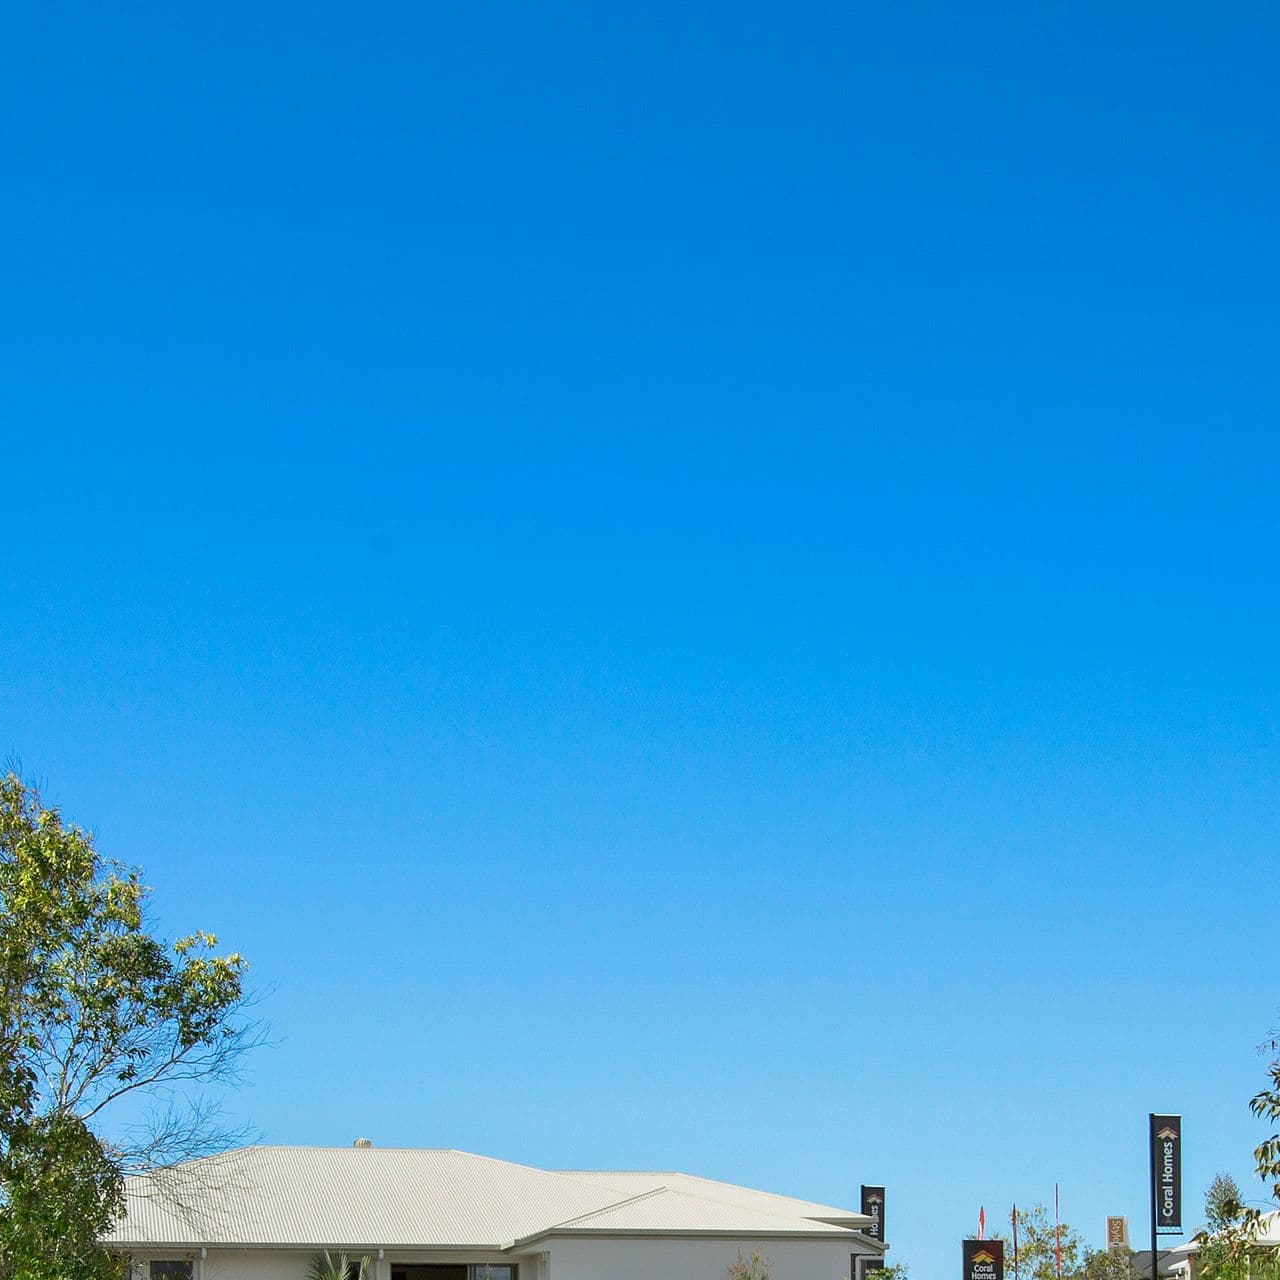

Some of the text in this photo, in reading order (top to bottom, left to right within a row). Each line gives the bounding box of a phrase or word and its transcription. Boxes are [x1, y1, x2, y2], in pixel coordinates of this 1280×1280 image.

[1162, 1141, 1174, 1217] Coral Homes
[973, 1264, 994, 1273] Coral
[971, 1271, 997, 1280] Homes
